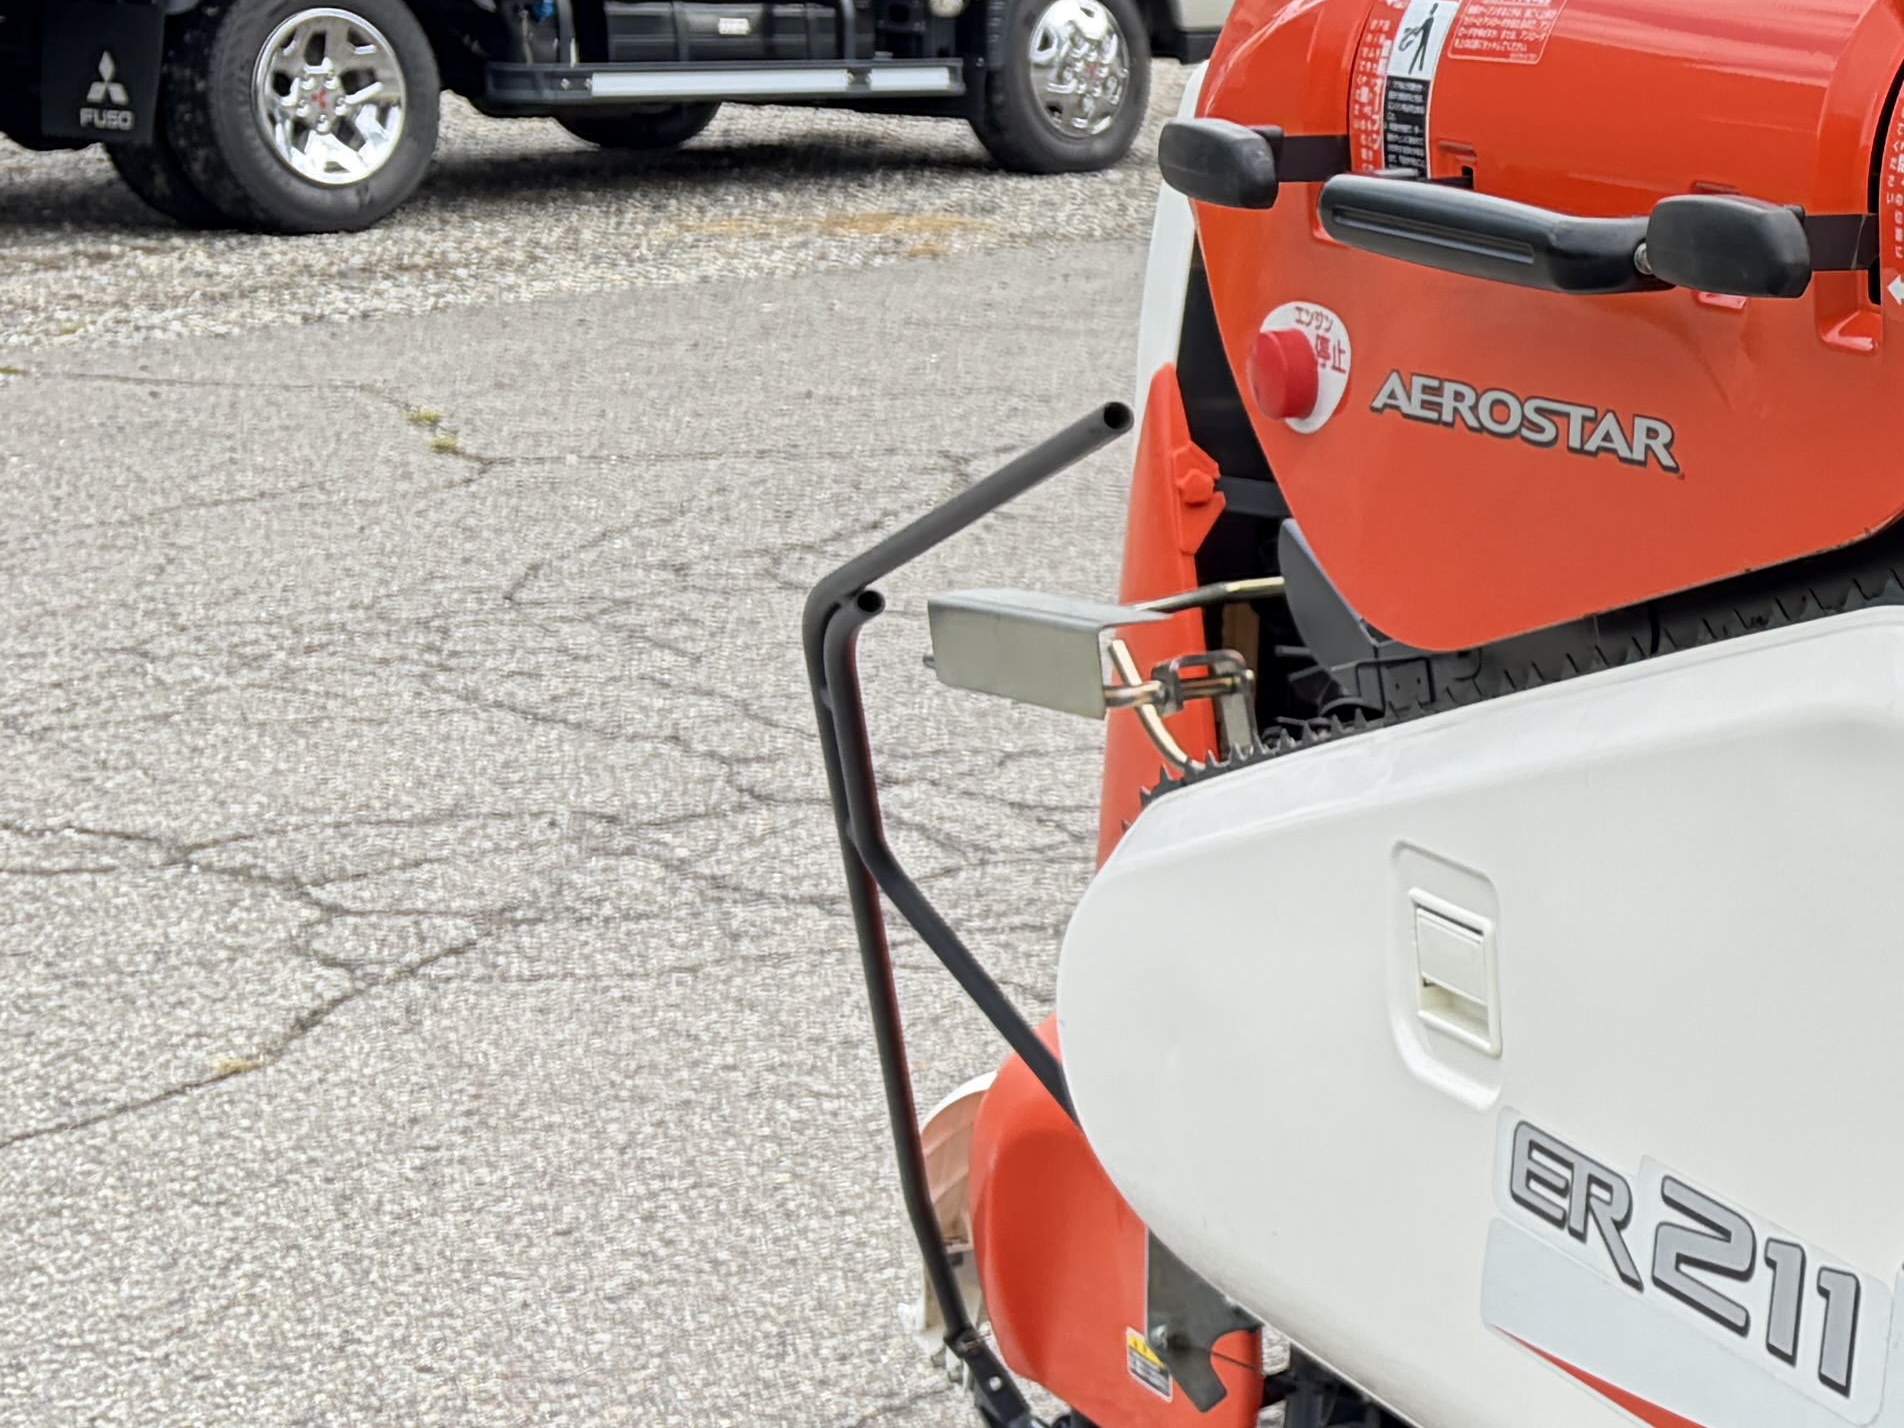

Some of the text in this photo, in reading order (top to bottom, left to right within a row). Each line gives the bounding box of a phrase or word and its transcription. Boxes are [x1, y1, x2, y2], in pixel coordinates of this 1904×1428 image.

[80, 107, 134, 130] FUSO
[1315, 333, 1346, 374] 停止
[1370, 369, 1680, 473] AEROSTAR
